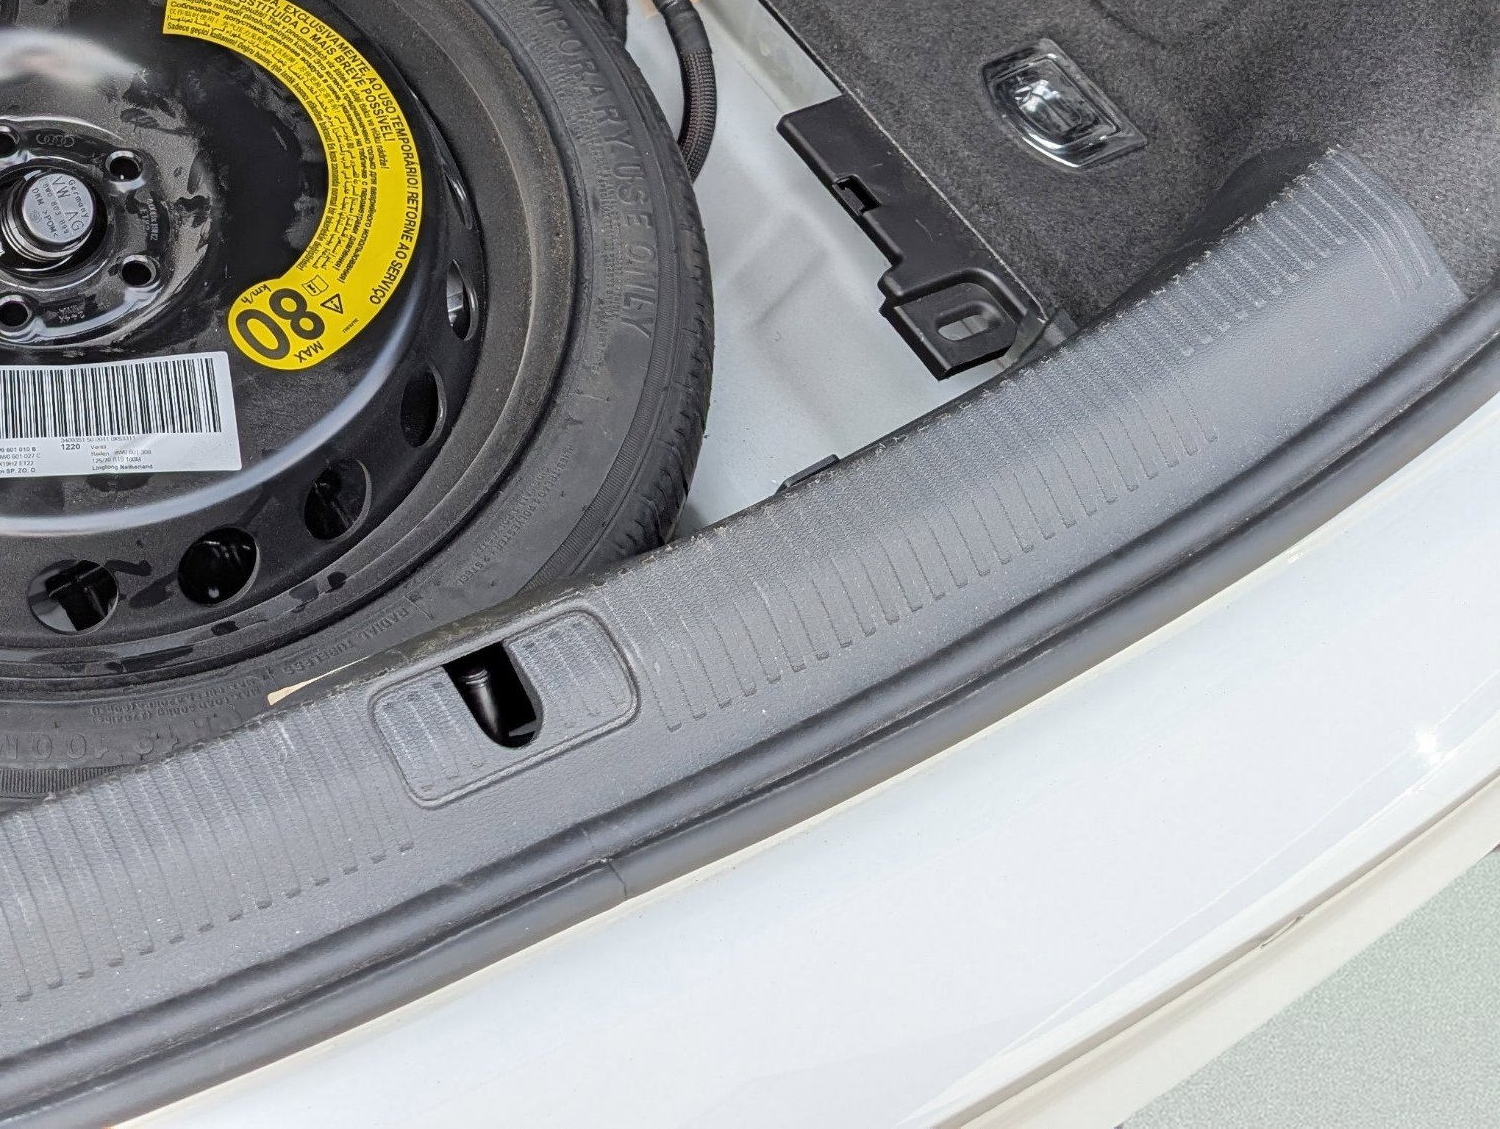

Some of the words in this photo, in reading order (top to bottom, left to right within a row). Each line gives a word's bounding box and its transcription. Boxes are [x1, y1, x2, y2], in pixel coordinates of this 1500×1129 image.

[299, 26, 310, 34] O
[309, 33, 336, 55] MAIS
[333, 54, 366, 86] BREVE
[365, 77, 382, 90] AO
[377, 92, 396, 113] USO
[52, 175, 71, 199] VW
[65, 211, 84, 231] AG
[68, 179, 90, 218] Germany
[400, 191, 418, 241] RETORNE
[613, 163, 655, 230] USE
[394, 242, 409, 259] AO
[240, 283, 272, 304] km/h
[369, 259, 402, 304] SERVIÇO
[622, 243, 657, 338] ONLY
[235, 288, 326, 361] 80
[293, 340, 325, 364] MAX
